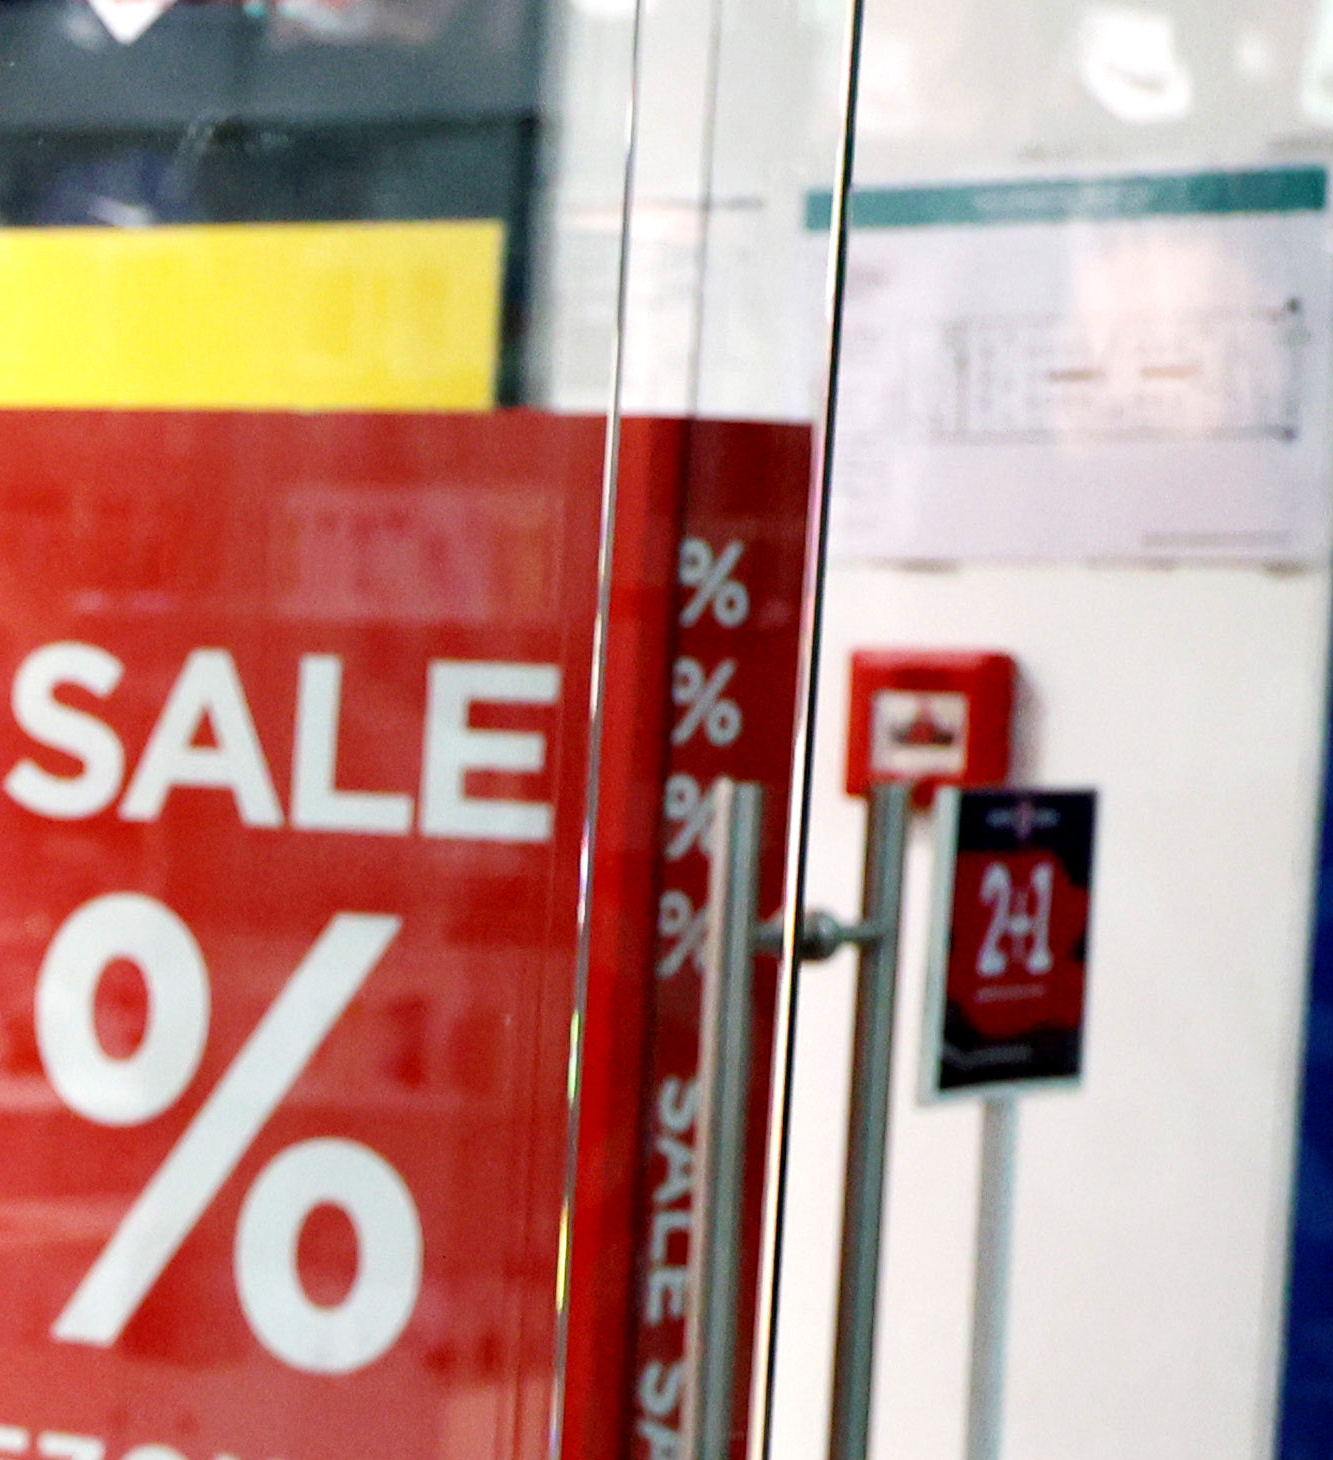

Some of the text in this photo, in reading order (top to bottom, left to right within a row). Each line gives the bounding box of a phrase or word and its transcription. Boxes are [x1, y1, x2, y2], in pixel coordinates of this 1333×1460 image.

[679, 538, 749, 628] %
[3, 641, 561, 841] SALE
[671, 656, 742, 746] %
[36, 891, 424, 1376] %
[644, 1076, 697, 1326] SALE
